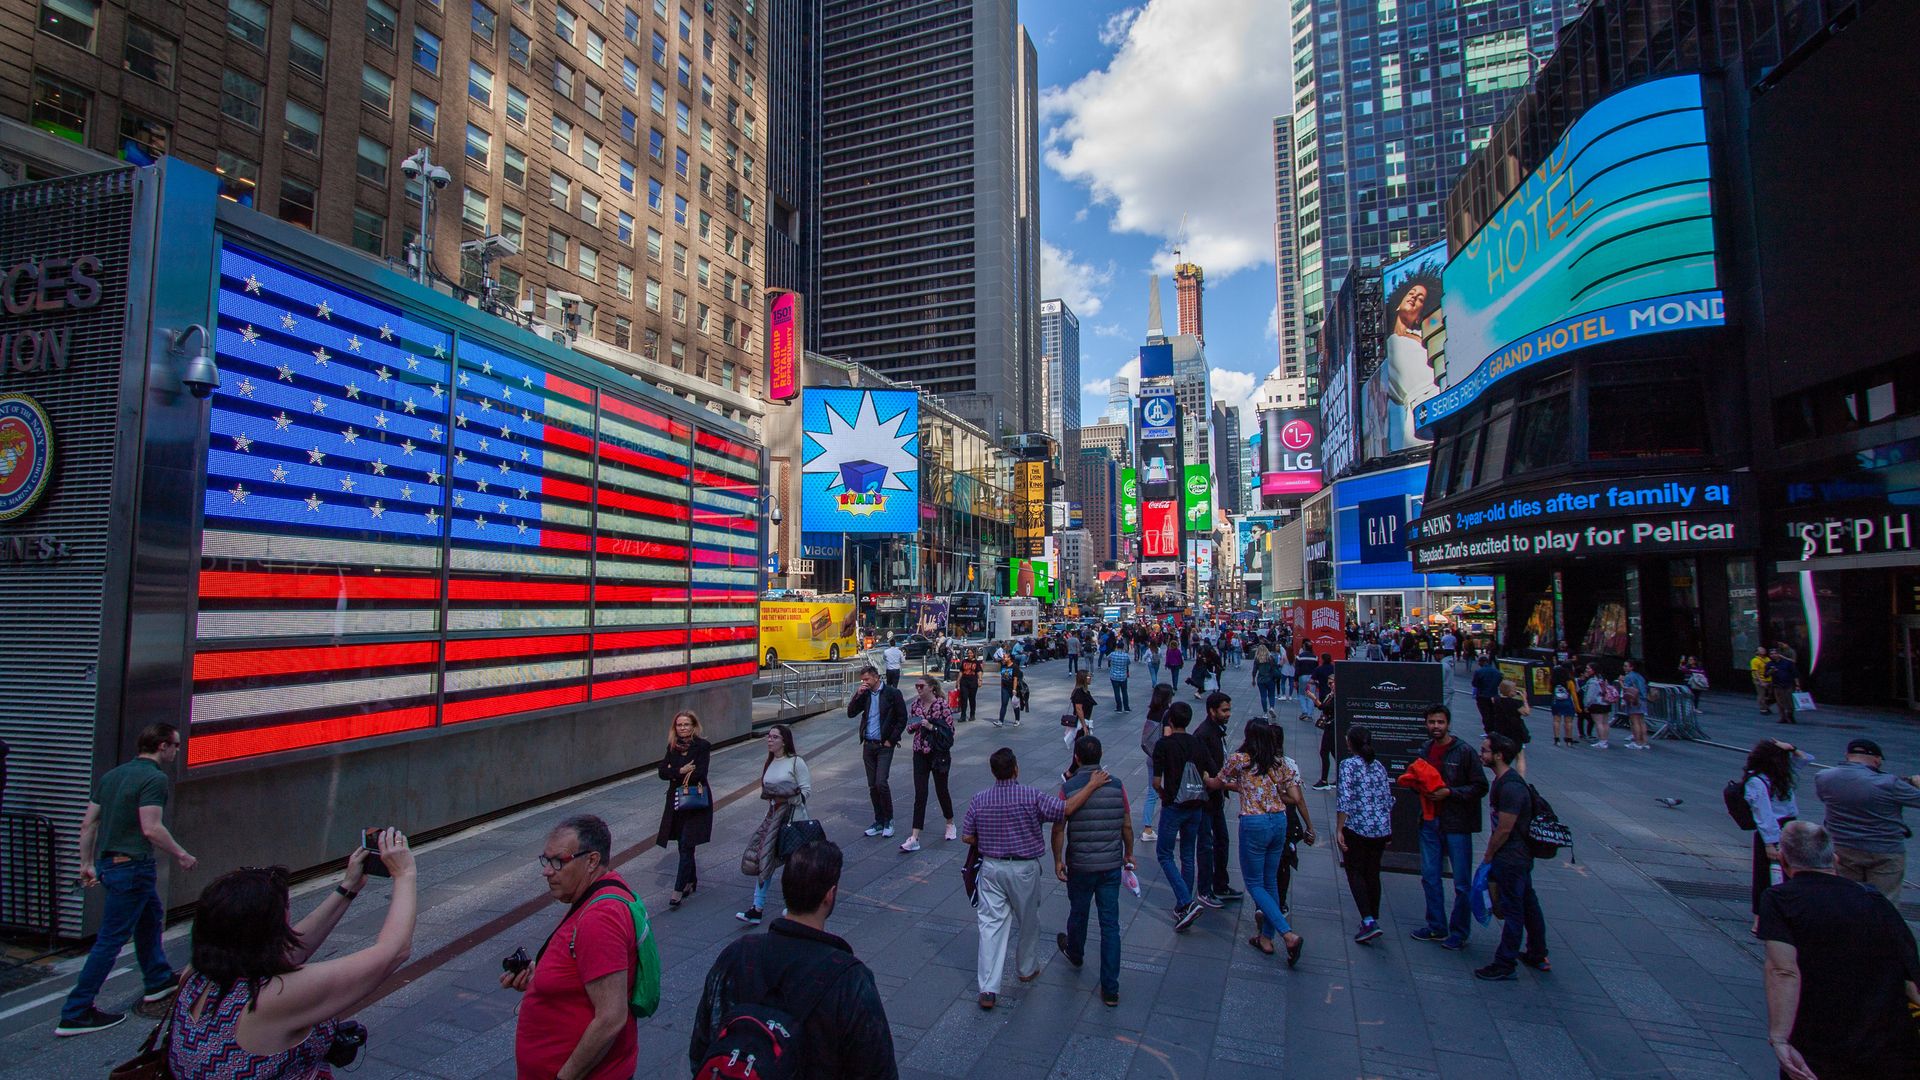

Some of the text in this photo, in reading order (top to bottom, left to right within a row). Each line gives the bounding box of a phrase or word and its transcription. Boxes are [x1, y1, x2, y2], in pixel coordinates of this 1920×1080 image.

[1487, 165, 1593, 295] HOTEL
[0, 255, 103, 314] CES
[773, 306, 792, 321] 1501
[773, 330, 781, 389] FLAGSHIP
[1432, 391, 1459, 417] SERIES
[1489, 342, 1533, 378] GRAND
[1538, 316, 1615, 355] HOTEL
[1629, 298, 1726, 330] MOND
[11, 405, 20, 414] OF
[20, 407, 33, 420] THE
[31, 417, 44, 446] NAVY
[8, 484, 33, 506] MARINE
[31, 456, 43, 483] CORPS
[1283, 452, 1313, 471] LG
[1427, 514, 1451, 536] NEWS
[1456, 503, 1506, 530] 2-year-old
[1509, 498, 1543, 518] dies
[1546, 491, 1600, 513] after
[1606, 482, 1696, 507] family
[1368, 514, 1397, 546] GAP
[1419, 545, 1444, 565] Stepdad:
[1444, 541, 1468, 559] Zion's
[1470, 535, 1510, 556] excited
[1512, 536, 1529, 552] to
[1533, 531, 1579, 553] play
[1585, 527, 1625, 546] for
[1801, 514, 1910, 558] SEPH
[1306, 540, 1326, 561] OLD NAVY
[1312, 607, 1335, 620] DESIGN
[1312, 616, 1340, 631] PAVILION
